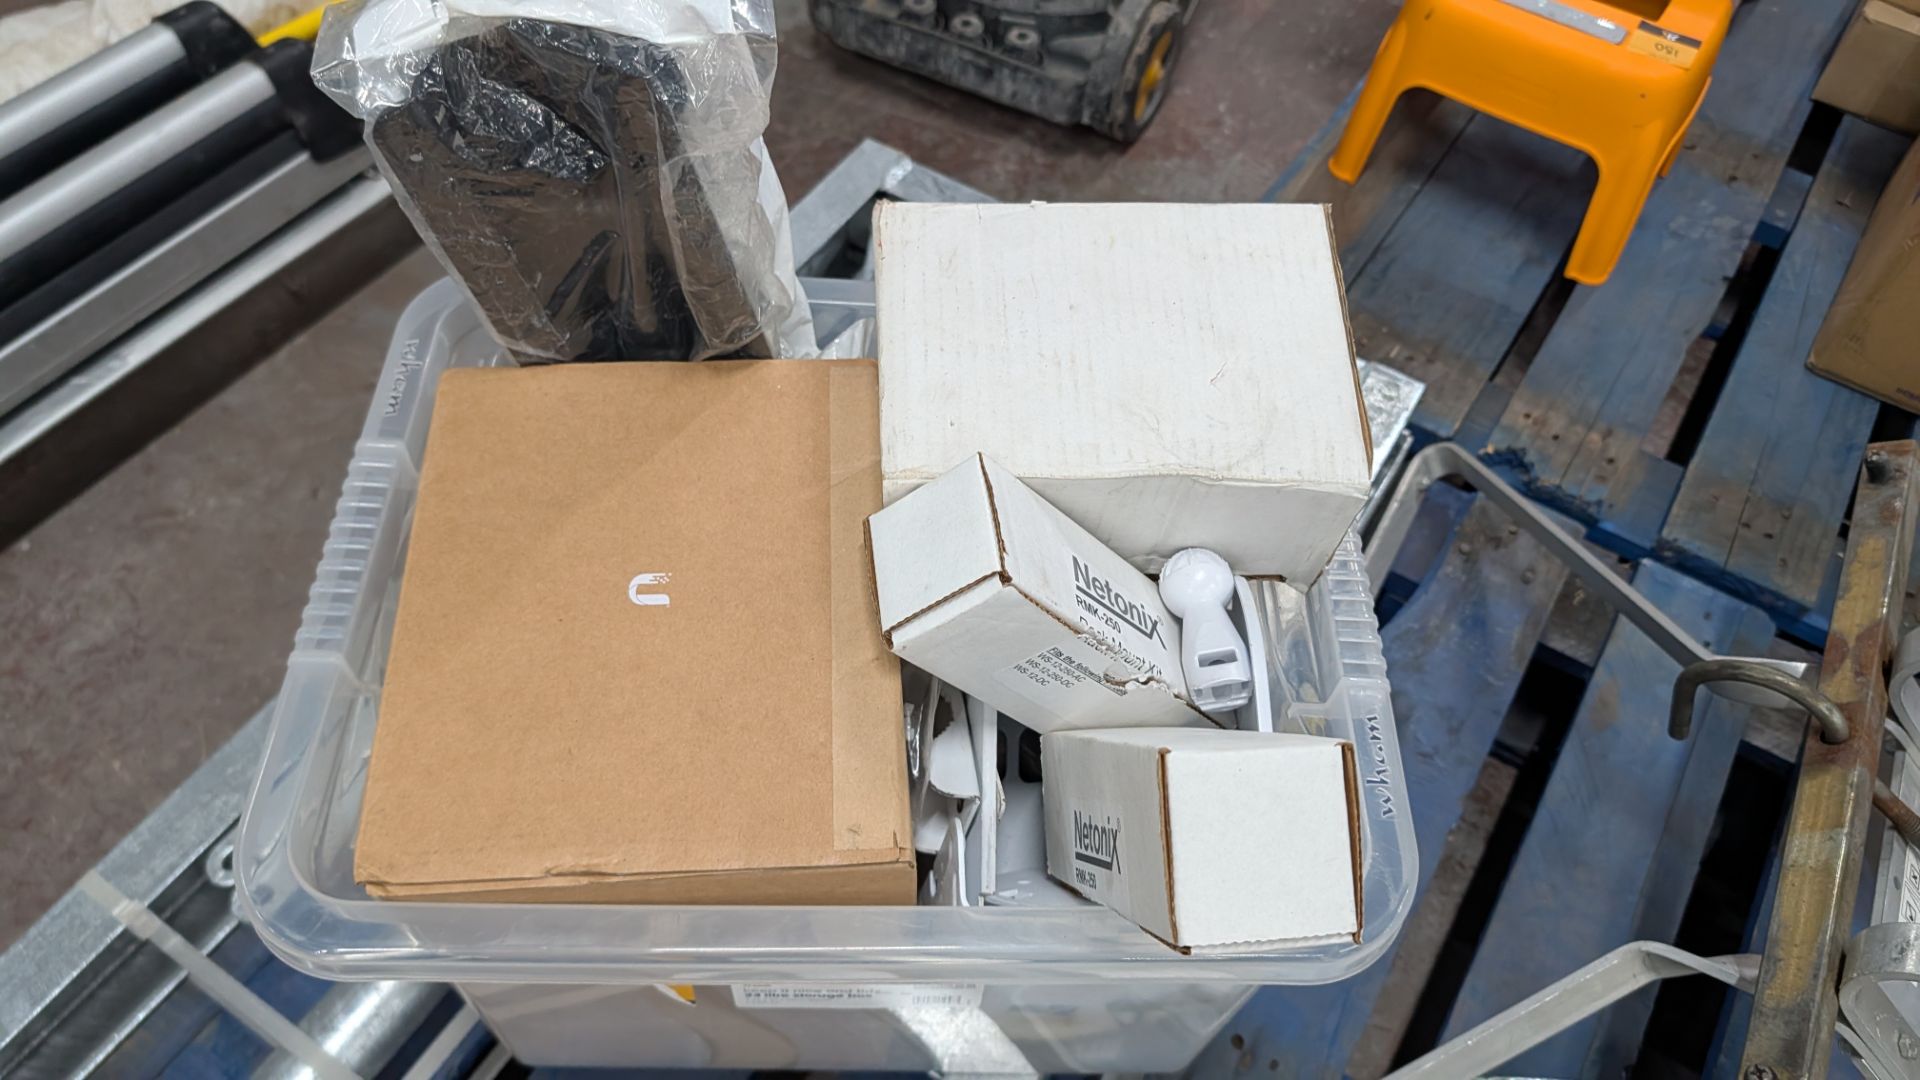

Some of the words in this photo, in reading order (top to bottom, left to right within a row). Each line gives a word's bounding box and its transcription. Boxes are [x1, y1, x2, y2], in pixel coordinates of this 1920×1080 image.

[1072, 554, 1167, 651] Netonix
[1075, 594, 1121, 634] RMK-250
[1037, 652, 1086, 683] WS-12-250-AC
[1049, 646, 1064, 659] Fits
[1063, 655, 1076, 666] the
[1013, 664, 1050, 687] WS-12-DC
[1025, 658, 1075, 689] WS-12-250-DC
[1074, 809, 1121, 875] Netonix
